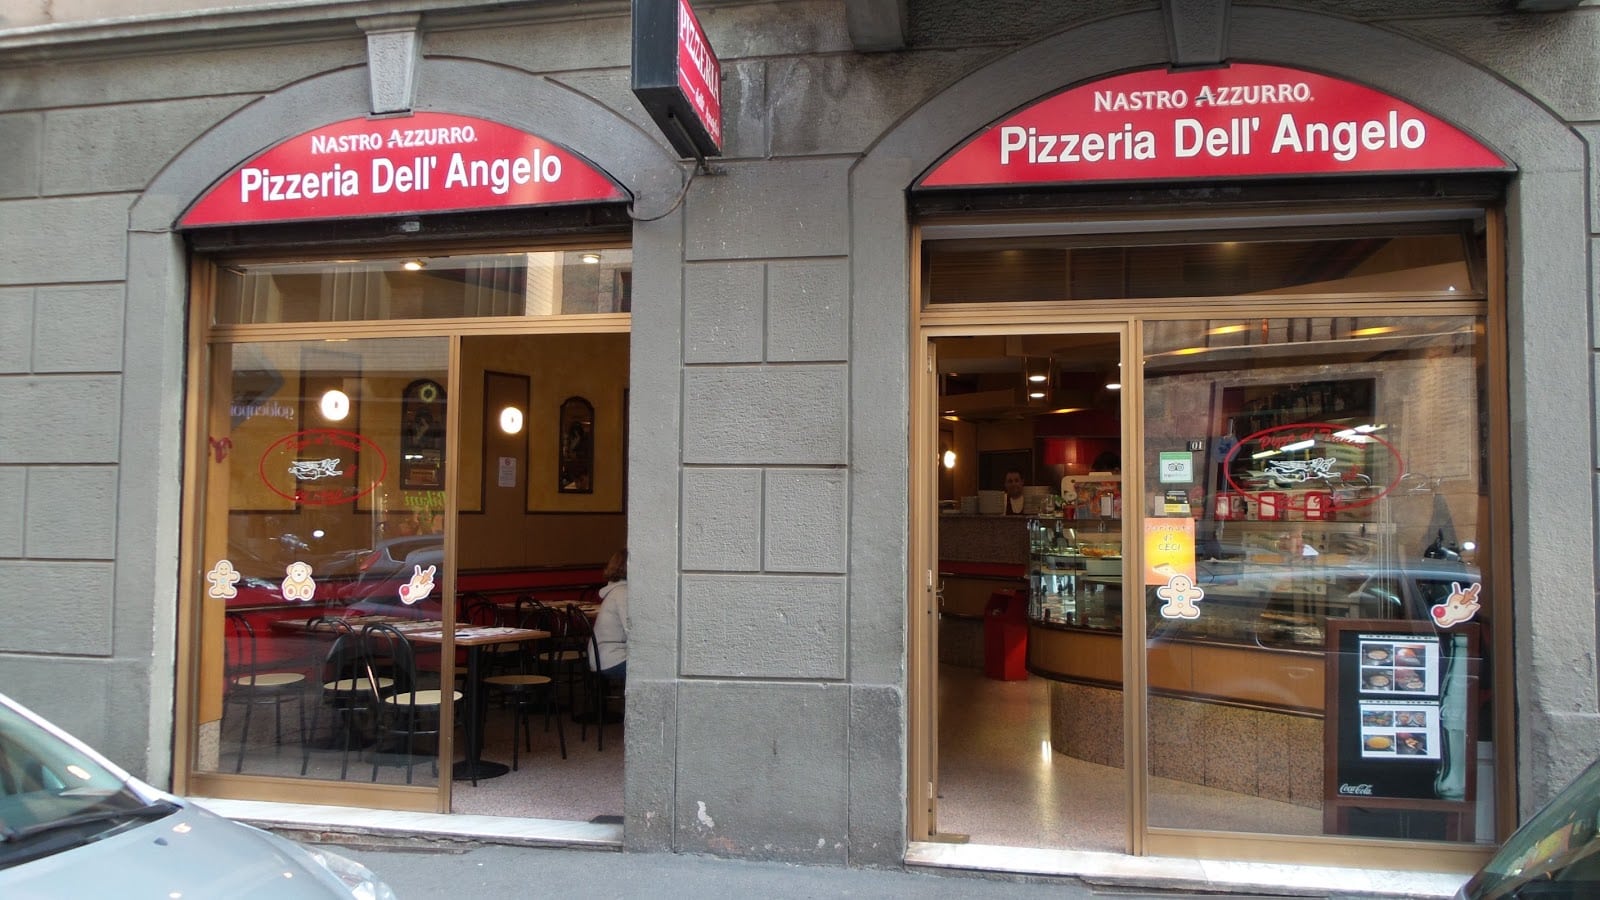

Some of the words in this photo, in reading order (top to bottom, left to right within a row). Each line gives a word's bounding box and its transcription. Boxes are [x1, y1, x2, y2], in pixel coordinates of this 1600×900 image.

[680, 1, 720, 106] PIZZERIA
[1094, 90, 1188, 112] NASTRO
[310, 132, 383, 155] NASTRO
[1000, 123, 1156, 165] Pizzeria
[1174, 117, 1261, 159] Dell'
[1271, 110, 1426, 163] Angelo
[241, 162, 359, 204] Pizzeria
[371, 154, 438, 194] Dell'
[444, 147, 563, 197] Angelo
[1158, 543, 1181, 551] CECI
